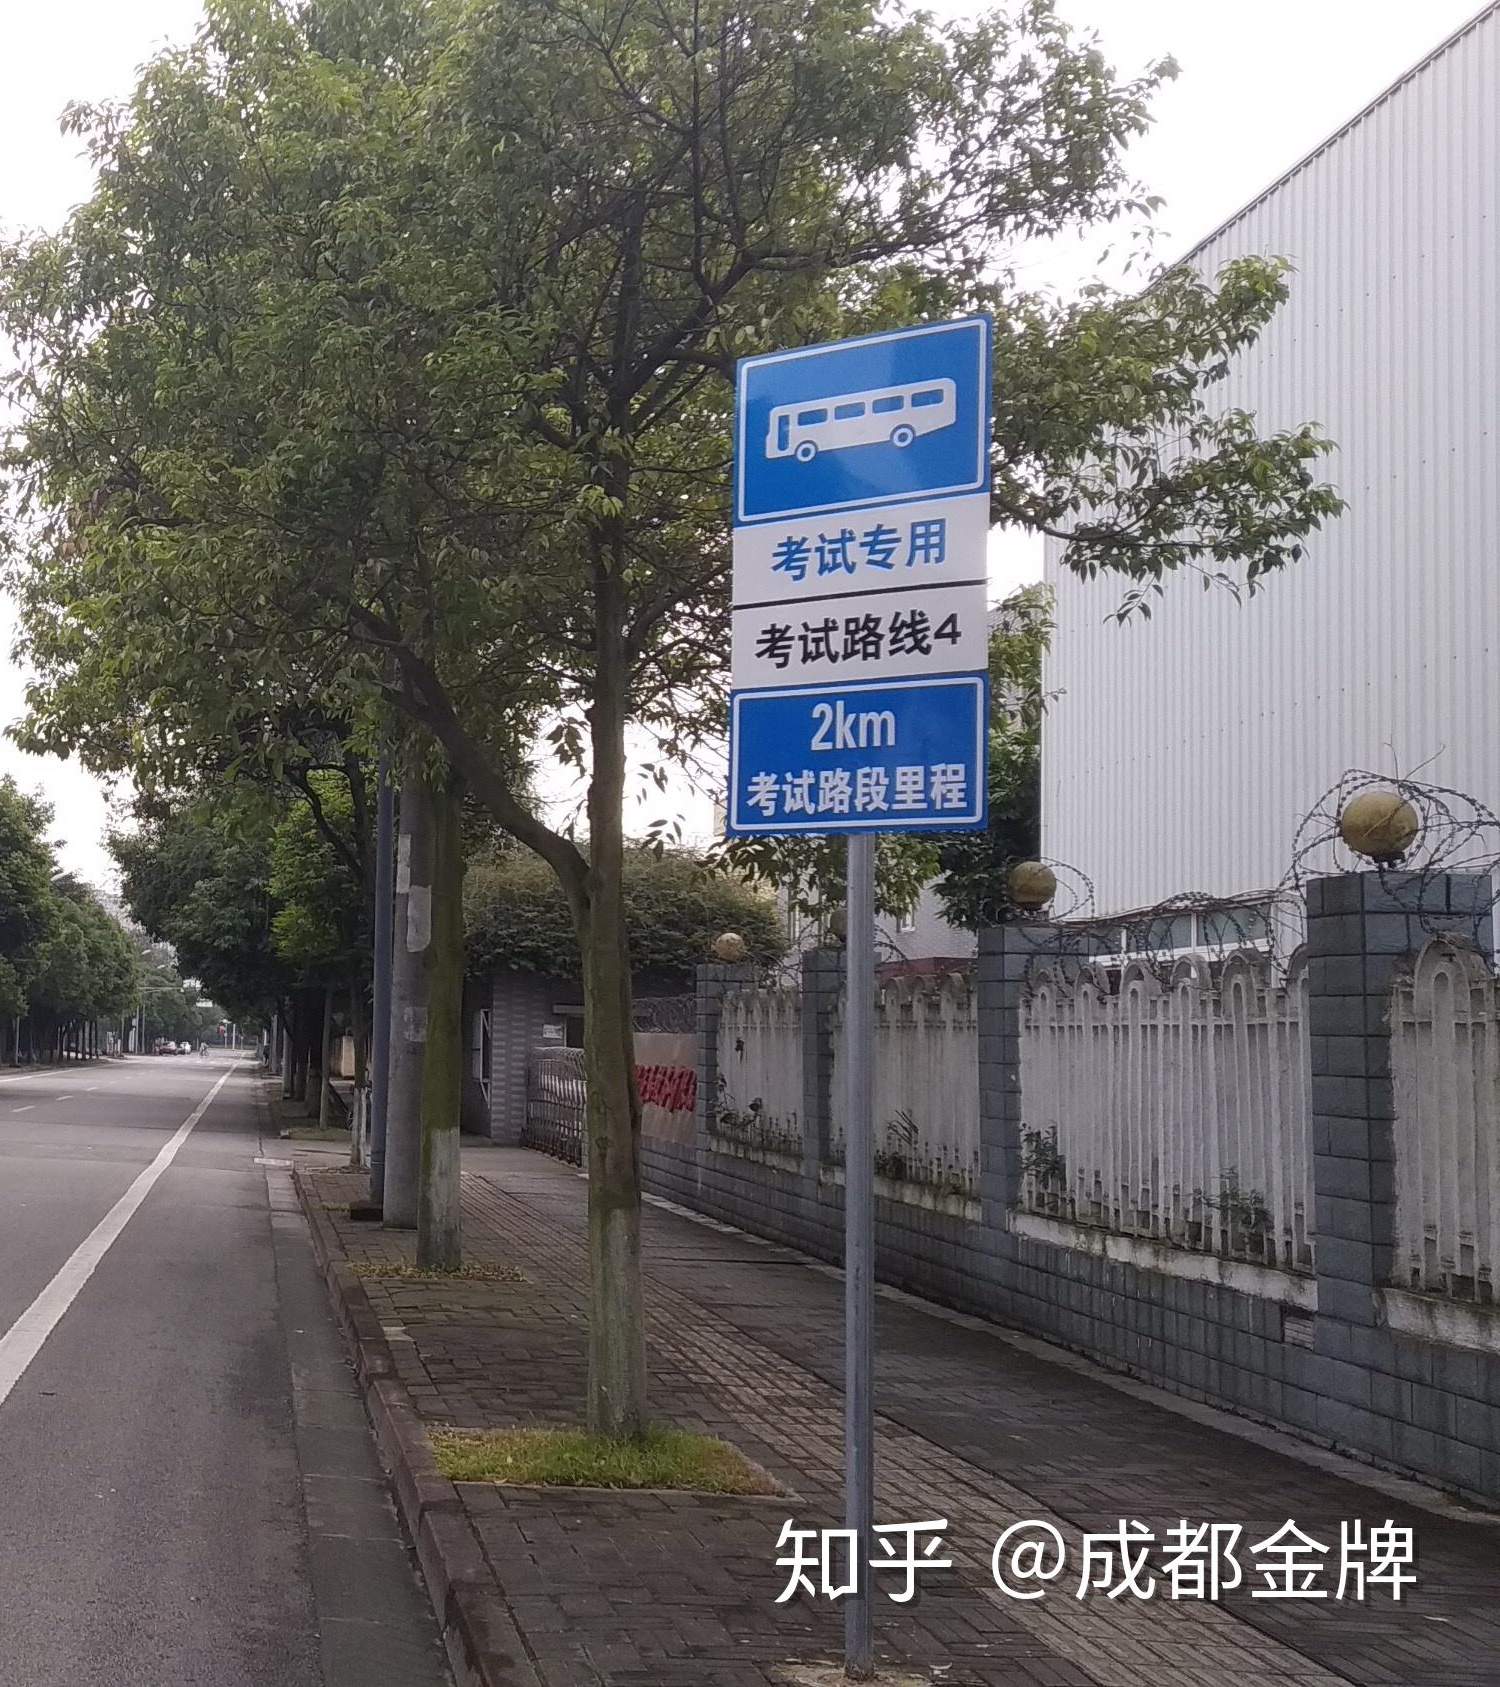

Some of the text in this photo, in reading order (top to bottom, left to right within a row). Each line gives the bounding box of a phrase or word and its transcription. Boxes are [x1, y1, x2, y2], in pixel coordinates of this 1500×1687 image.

[771, 517, 947, 582] 考试专用
[755, 609, 963, 669] 考试路线4
[810, 700, 896, 751] 2km
[746, 762, 968, 817] 考试路段里程
